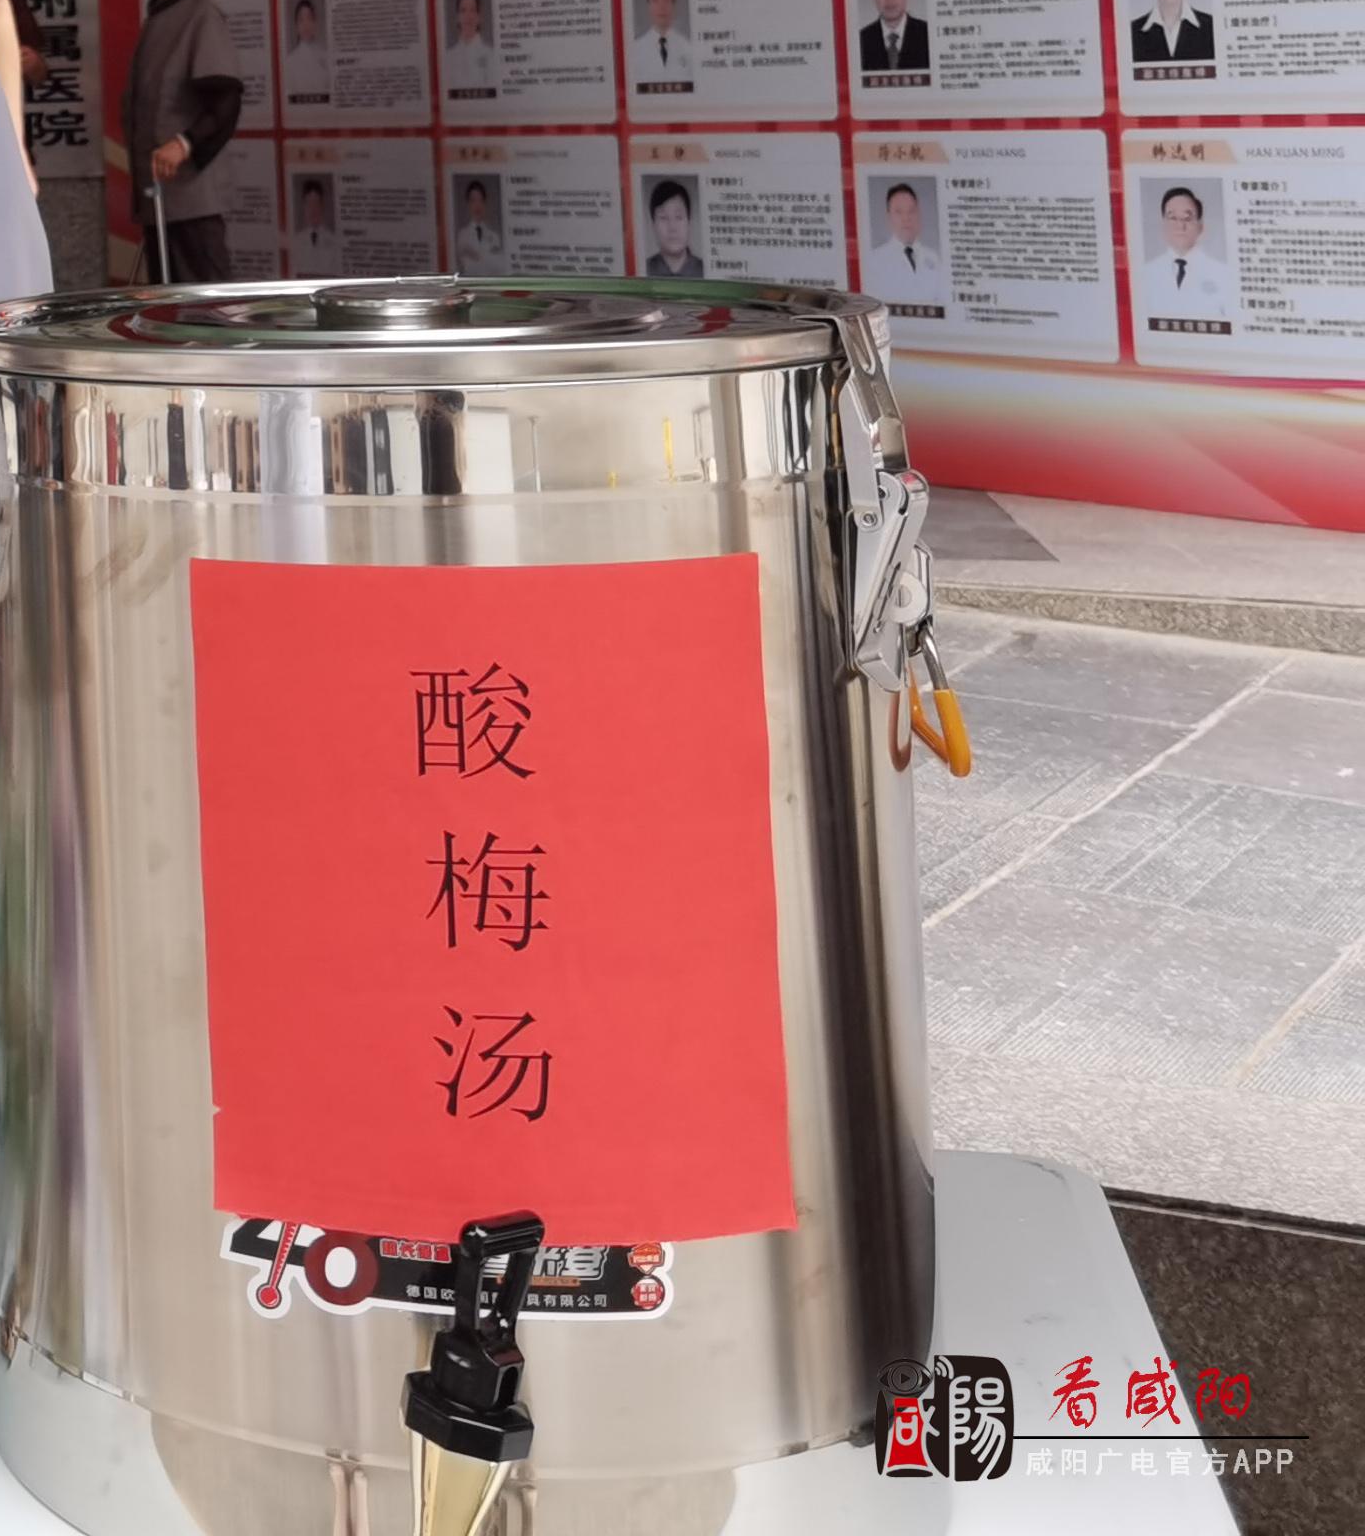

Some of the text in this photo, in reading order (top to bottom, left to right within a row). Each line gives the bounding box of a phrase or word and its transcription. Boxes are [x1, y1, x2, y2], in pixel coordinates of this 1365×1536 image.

[1246, 146, 1271, 158] HAN
[408, 662, 555, 1124] 酸梅汤
